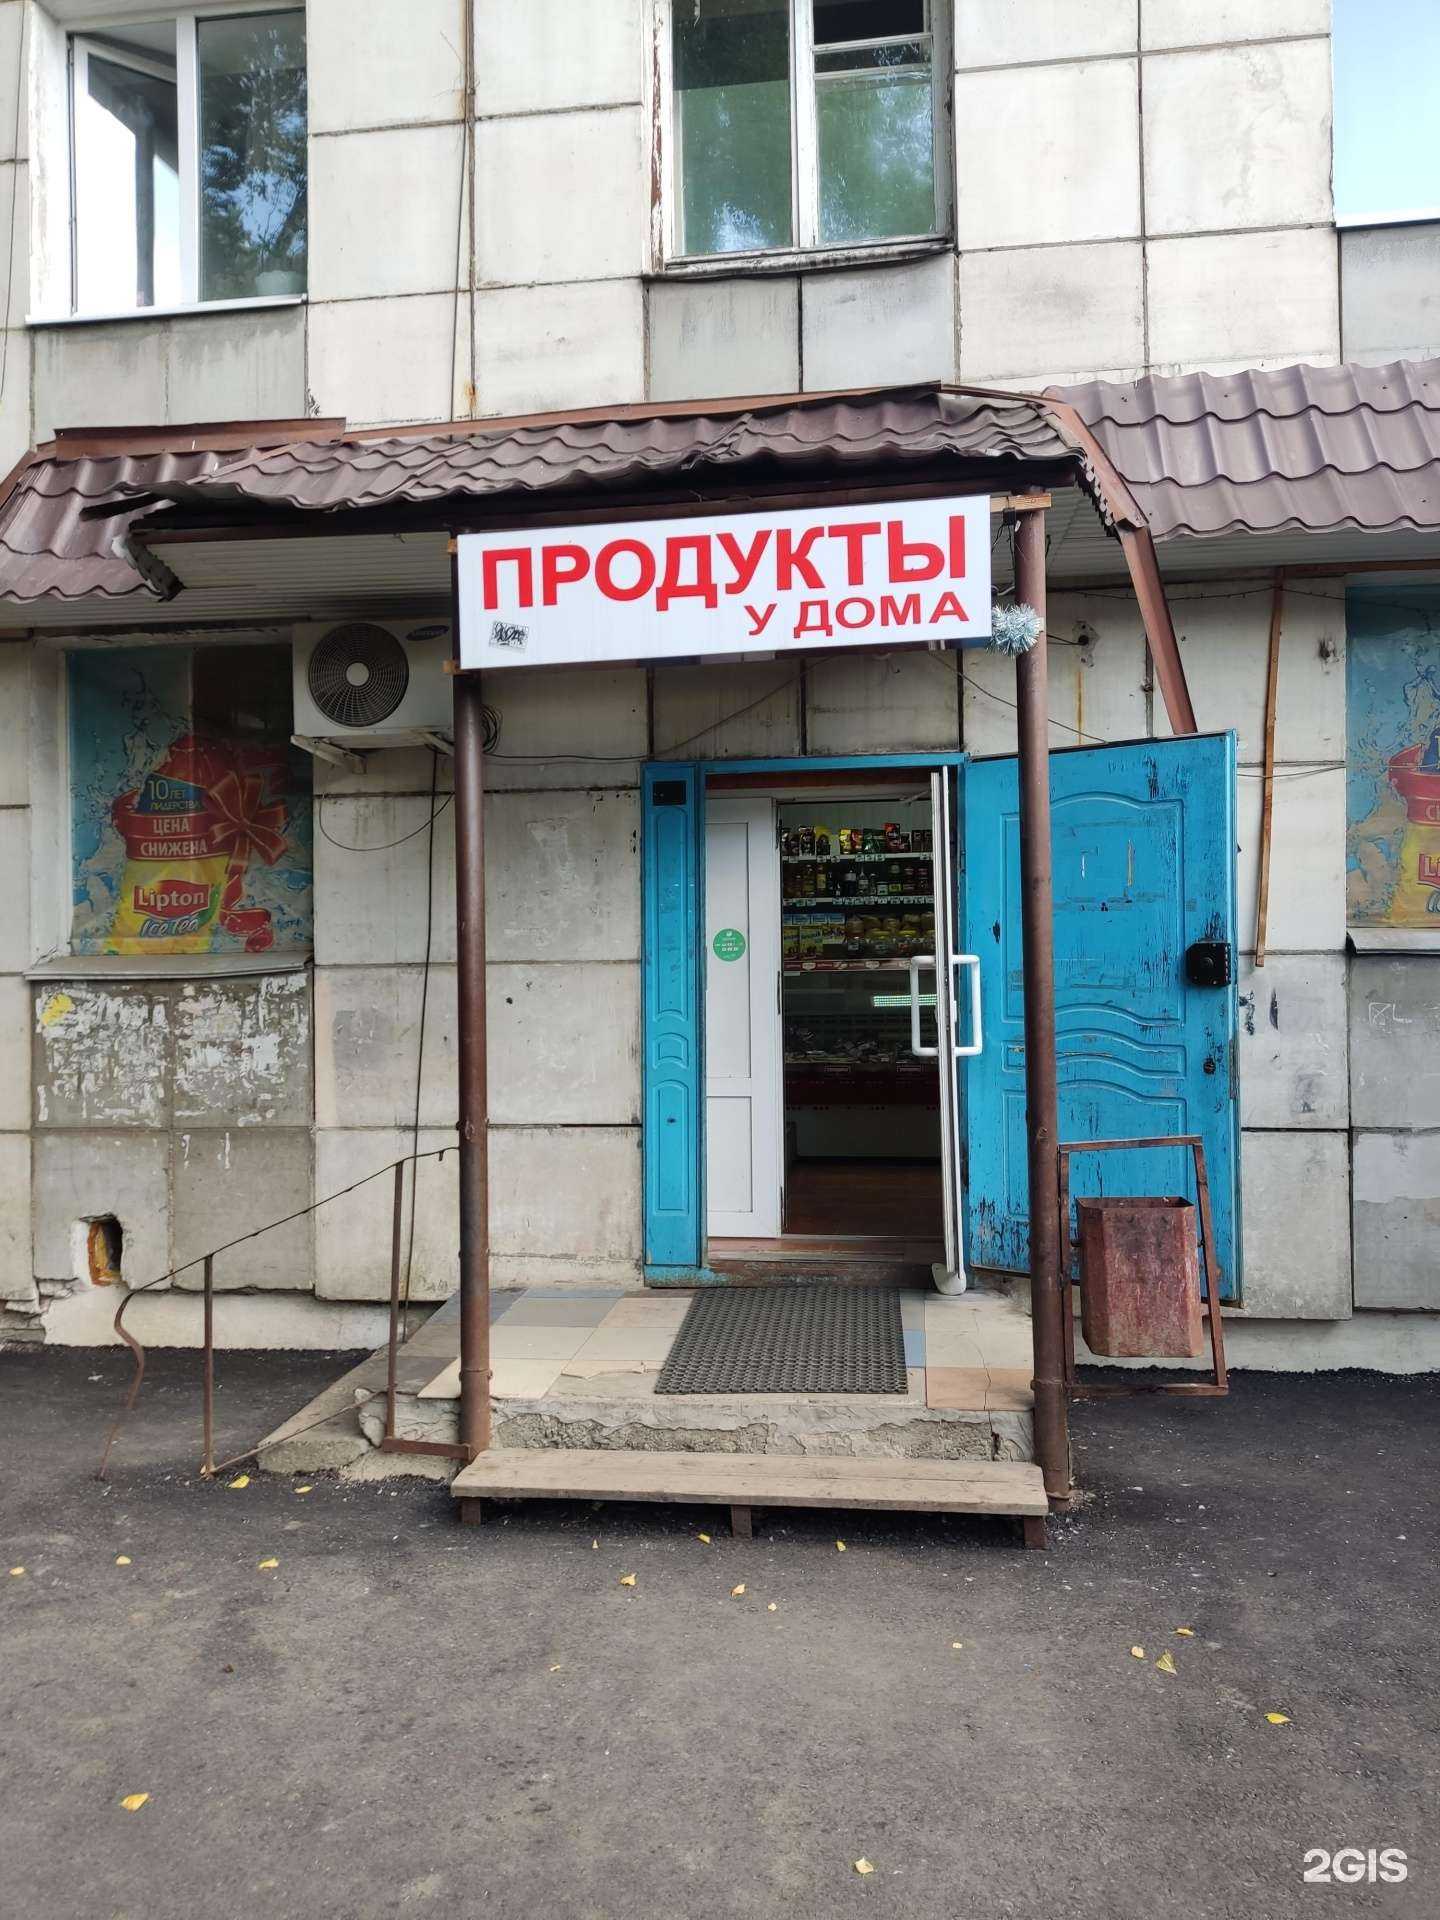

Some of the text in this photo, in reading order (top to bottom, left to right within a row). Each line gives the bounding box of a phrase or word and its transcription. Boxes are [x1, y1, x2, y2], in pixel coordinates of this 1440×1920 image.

[481, 515, 966, 613] ПРОДУКТЫ
[745, 591, 969, 639] У ДОМА
[148, 779, 169, 800] 10
[153, 817, 190, 836] ЦЕНА
[140, 838, 208, 857] СНИЖЕНА
[138, 889, 205, 911] Lipton
